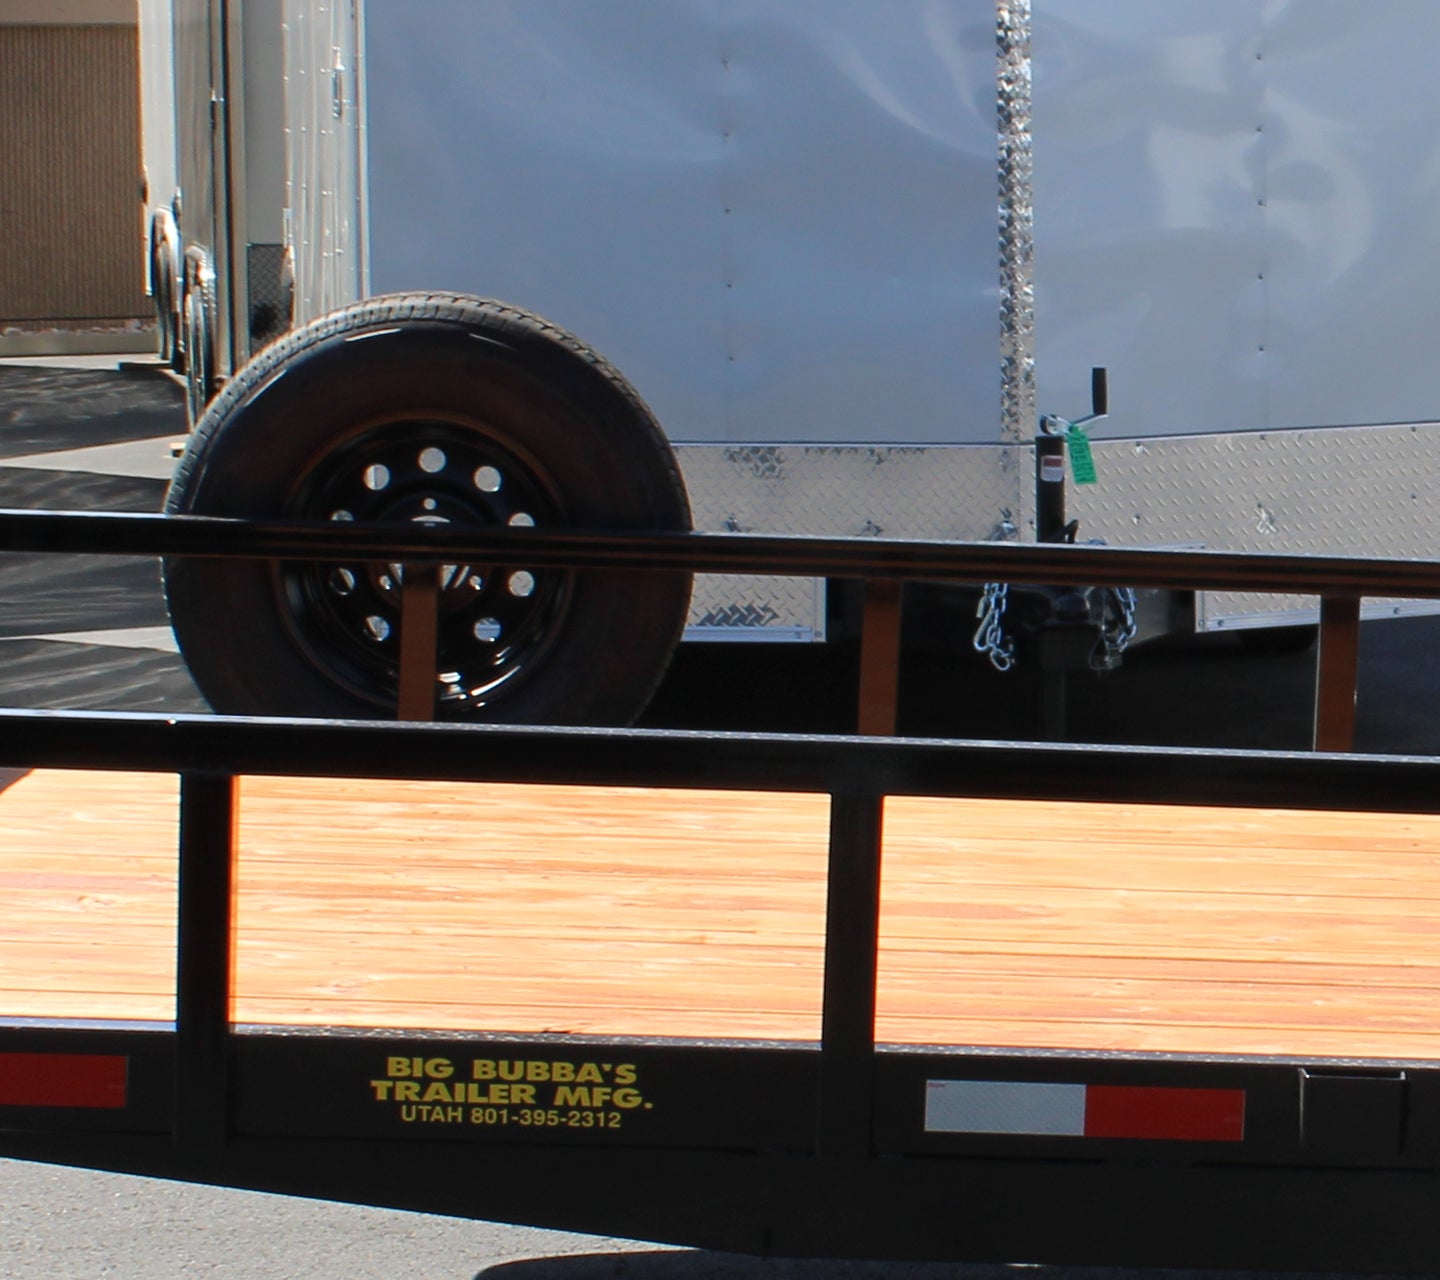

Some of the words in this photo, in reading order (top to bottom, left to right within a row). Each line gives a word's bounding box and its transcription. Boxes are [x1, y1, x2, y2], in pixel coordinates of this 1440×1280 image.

[387, 1057, 454, 1078] BIG
[472, 1059, 637, 1084] BUBBA'S
[370, 1080, 536, 1104] TRAILER
[553, 1086, 653, 1109] MFG.
[401, 1105, 463, 1123] UTAH
[471, 1108, 622, 1128] 801-395-2312
